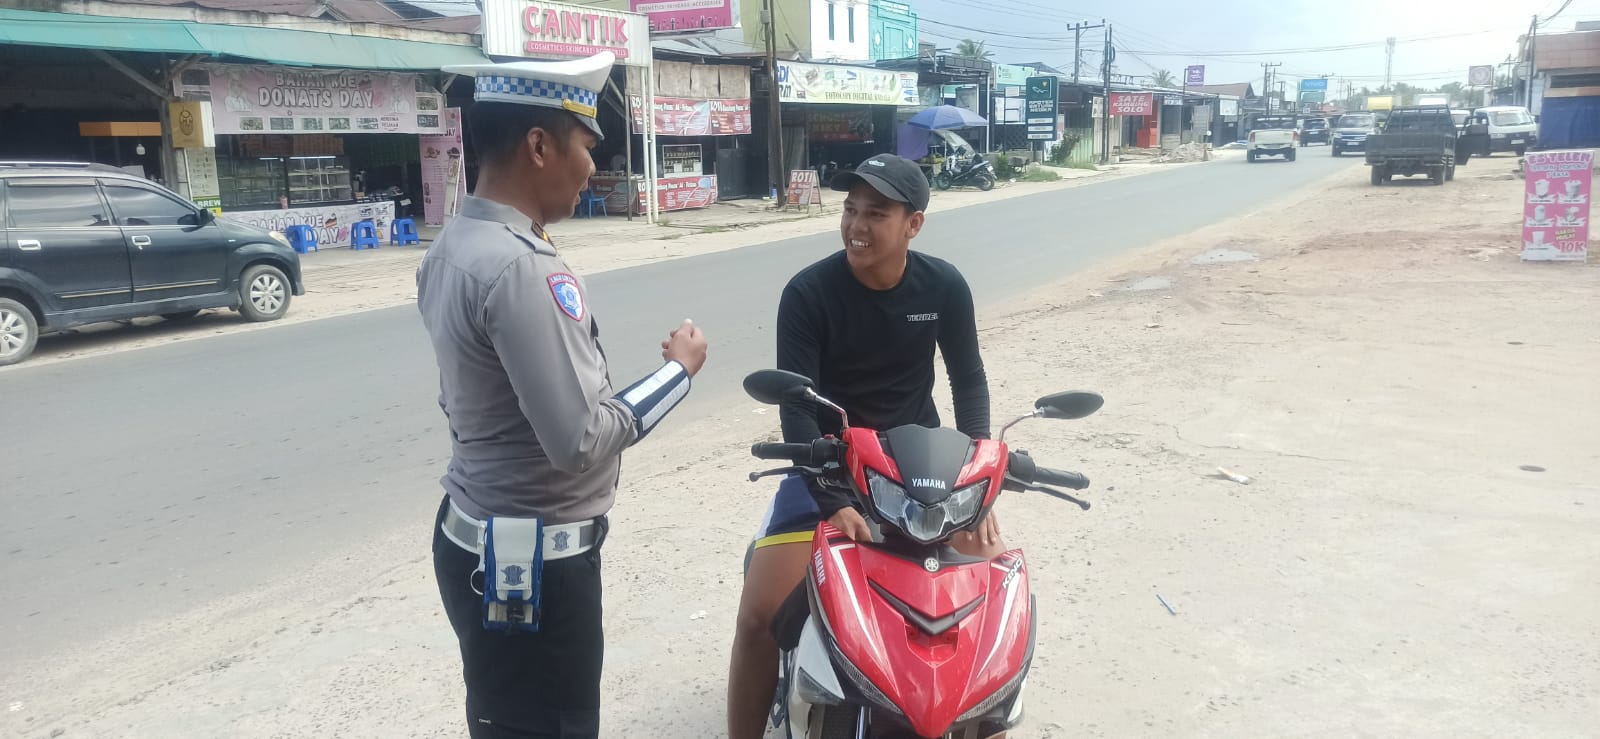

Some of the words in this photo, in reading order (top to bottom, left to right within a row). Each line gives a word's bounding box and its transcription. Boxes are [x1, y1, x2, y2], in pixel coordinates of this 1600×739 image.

[524, 6, 629, 44] CANTIK
[530, 43, 563, 53] COSMETICS
[565, 45, 593, 55] SKINCARE
[276, 73, 325, 88] BAHAN
[331, 75, 357, 88] KUE
[258, 87, 334, 107] DONATS
[339, 89, 373, 108] DAY
[791, 172, 812, 183] ROTI
[197, 199, 221, 208] BREW
[299, 215, 323, 229] KUE
[1559, 240, 1586, 253] 10K
[911, 477, 947, 490] YAMAHA
[814, 547, 827, 586] YAMAHA
